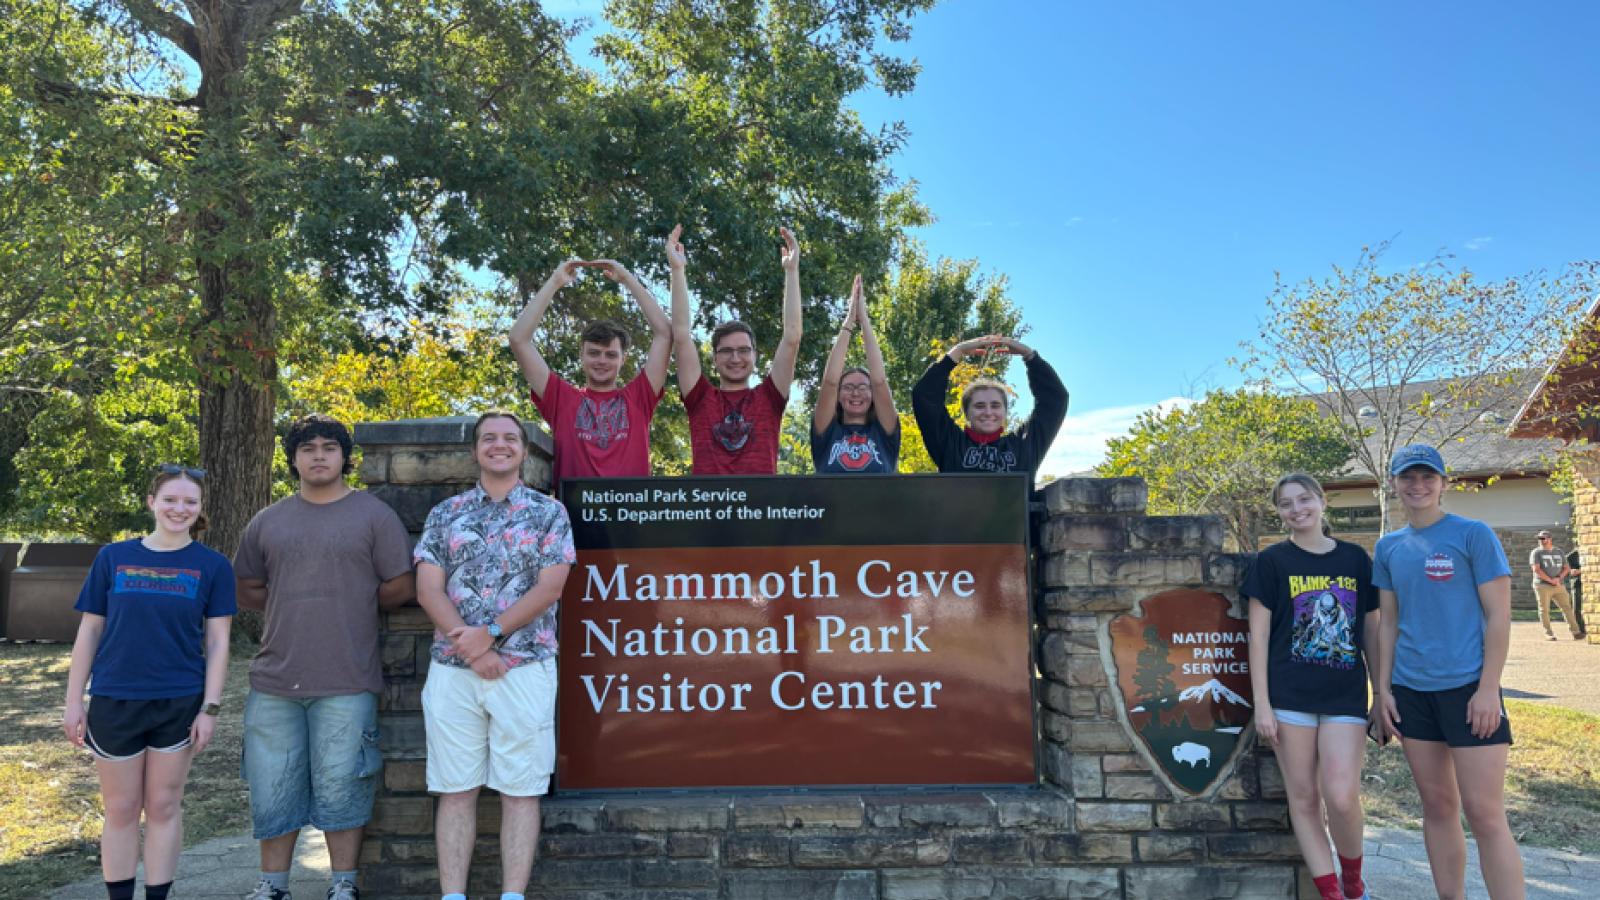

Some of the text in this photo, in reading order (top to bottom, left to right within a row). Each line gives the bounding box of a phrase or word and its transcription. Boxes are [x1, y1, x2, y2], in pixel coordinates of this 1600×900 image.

[582, 487, 747, 504] National Park Service
[582, 505, 826, 525] U.S. Department of the Interior
[582, 559, 976, 603] Mammoth Cave
[581, 613, 931, 658] National Park
[1193, 647, 1236, 659] PARK
[1182, 662, 1249, 674] SERVICE
[580, 671, 942, 713] Visitor Center
